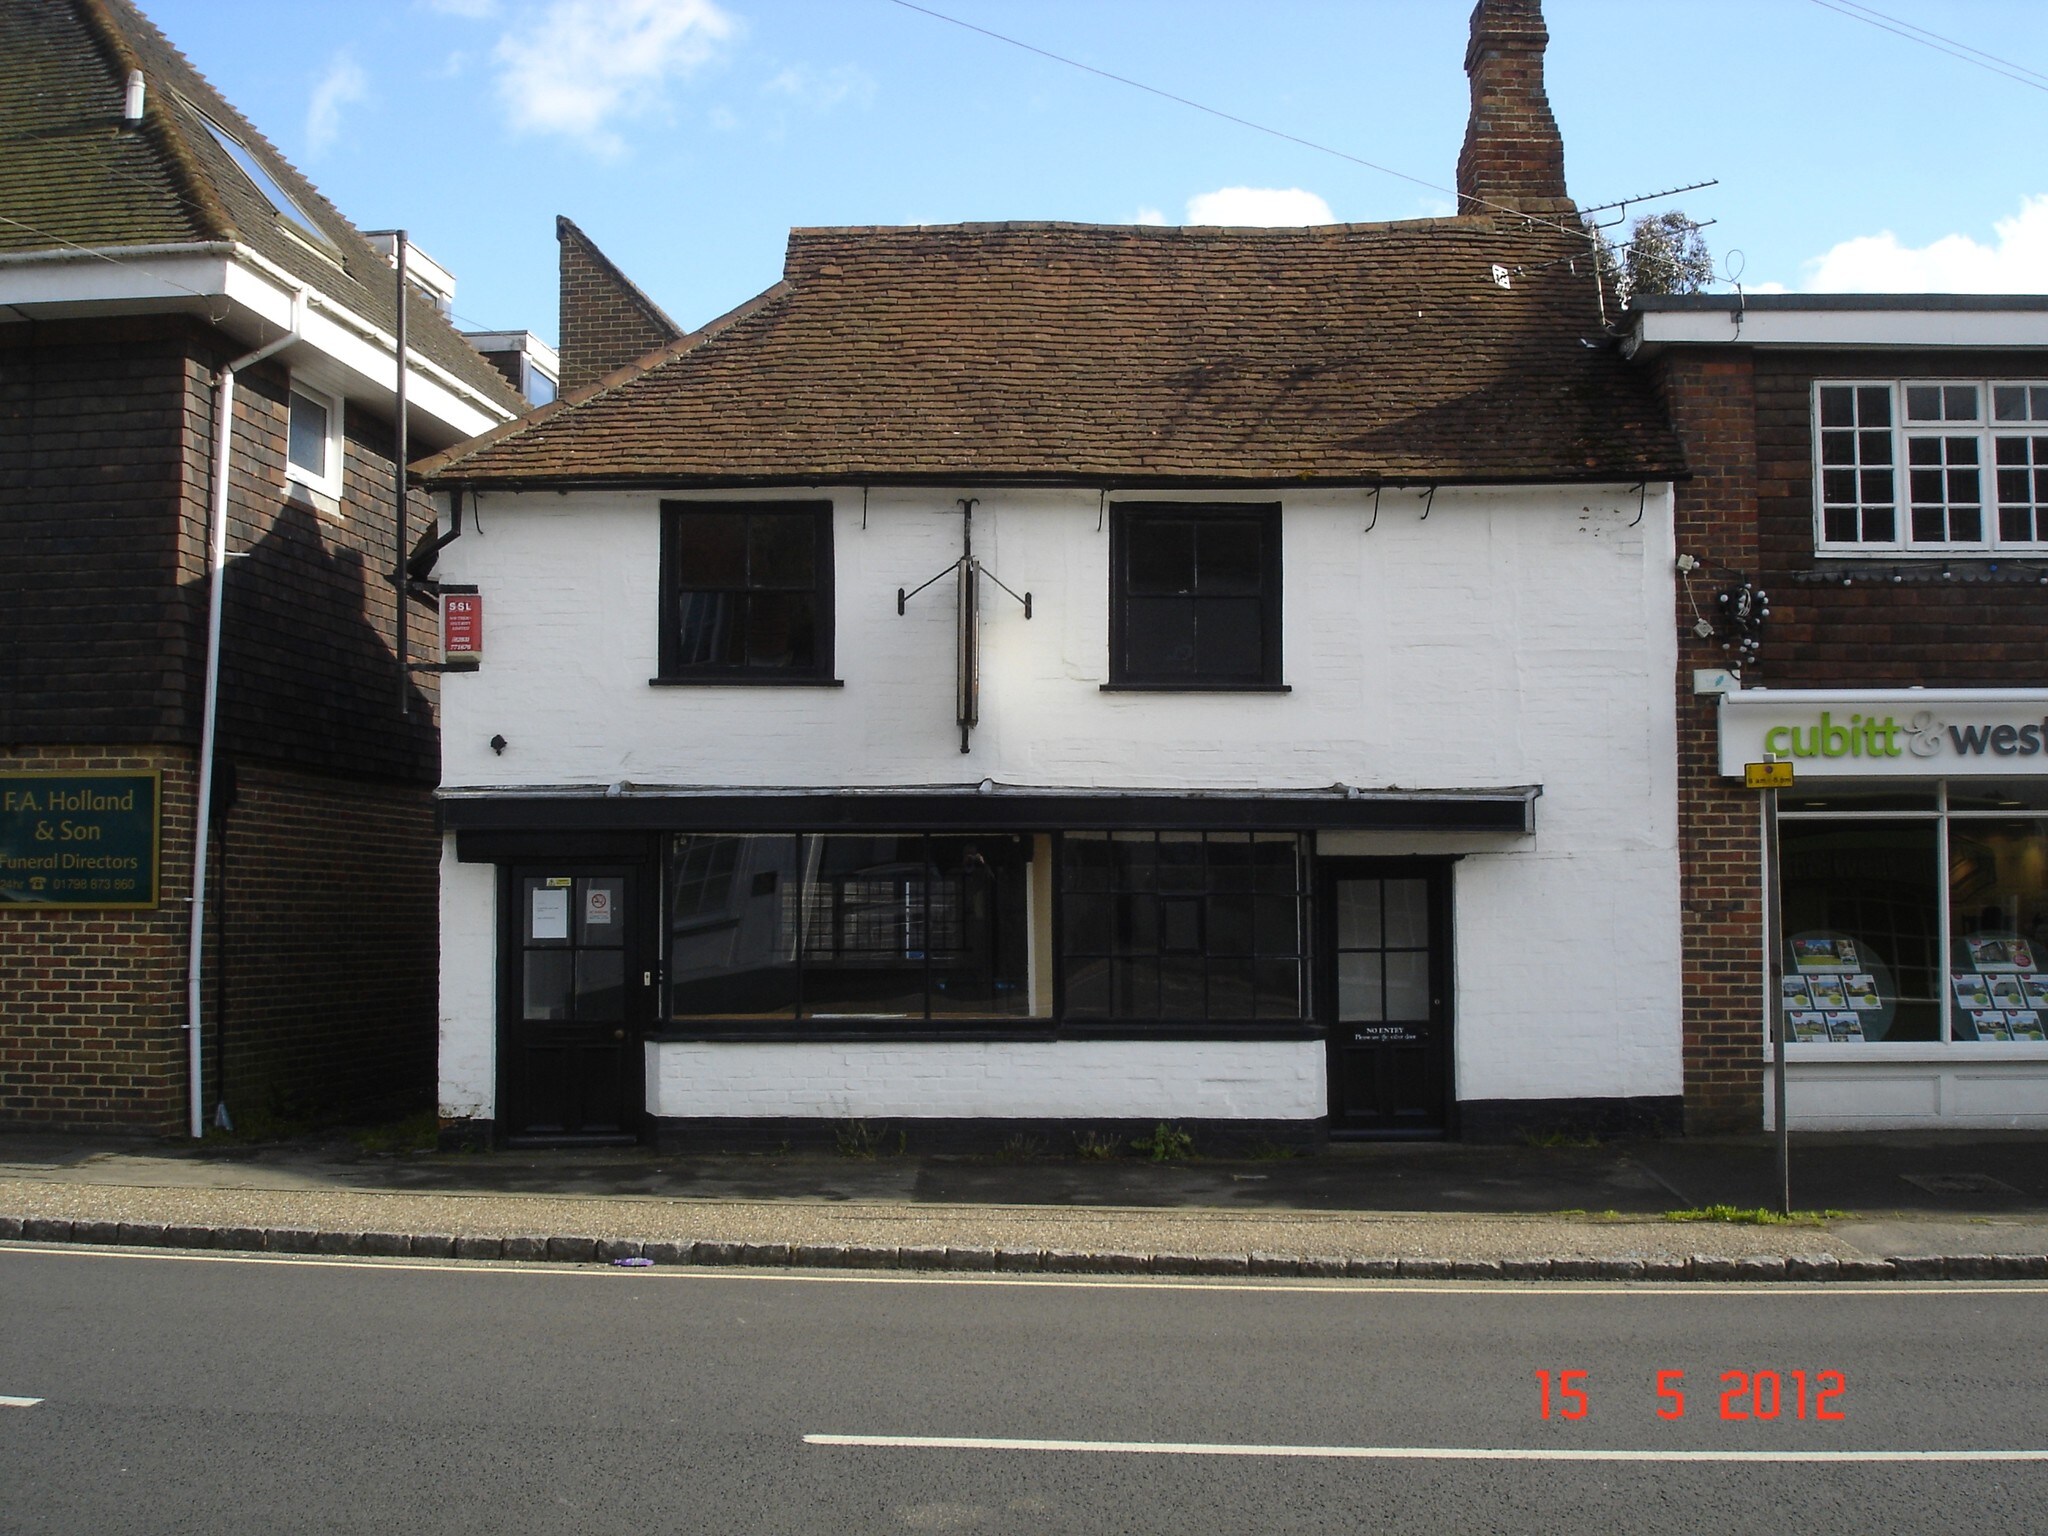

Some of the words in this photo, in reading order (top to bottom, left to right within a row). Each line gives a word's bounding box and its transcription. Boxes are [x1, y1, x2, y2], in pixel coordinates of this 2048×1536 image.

[449, 602, 472, 611] SSL
[1765, 711, 1902, 757] cubitt
[1903, 710, 1944, 757] &
[4, 791, 43, 811] F.A.
[49, 789, 133, 811] Holland
[35, 820, 54, 840] &
[60, 820, 101, 840] Son
[0, 853, 58, 869] Funeral
[62, 853, 138, 869] Directors
[53, 879, 87, 890] 01798
[90, 879, 111, 890] 873
[114, 879, 136, 890] 860
